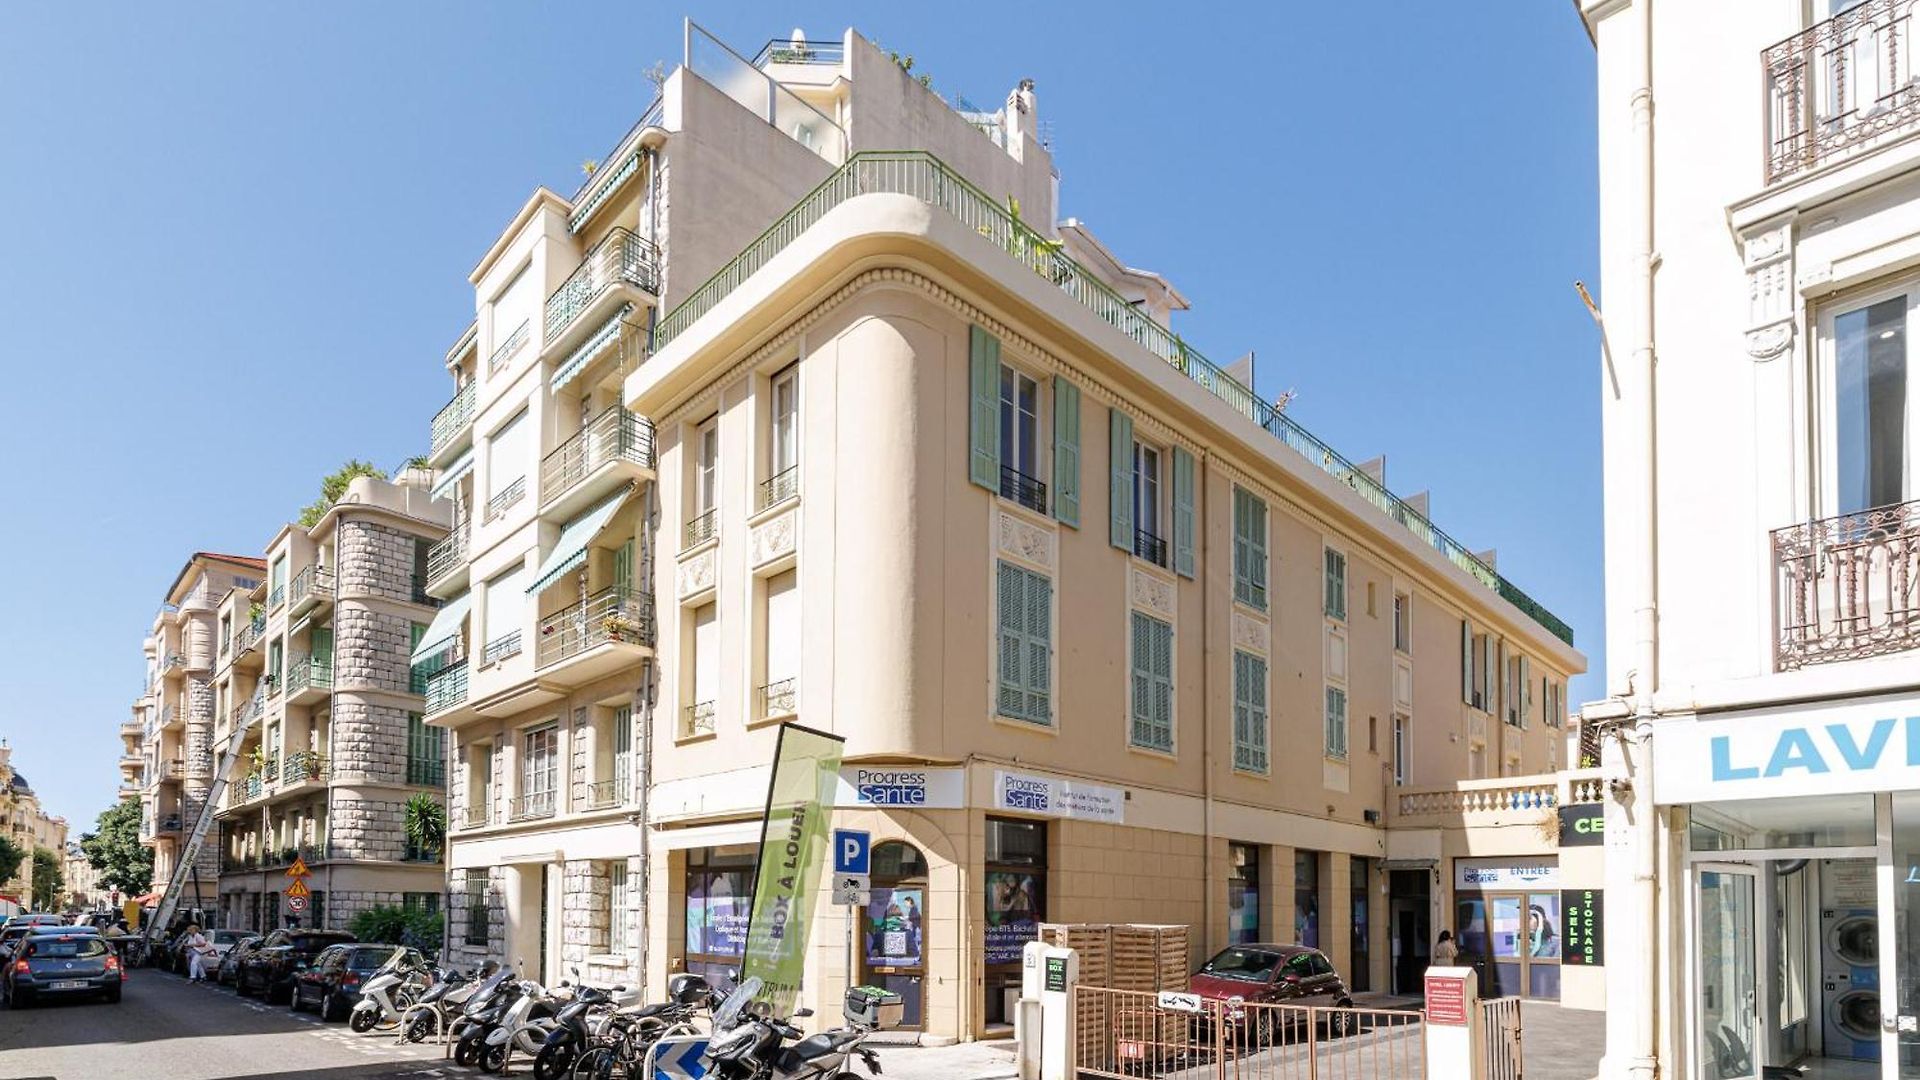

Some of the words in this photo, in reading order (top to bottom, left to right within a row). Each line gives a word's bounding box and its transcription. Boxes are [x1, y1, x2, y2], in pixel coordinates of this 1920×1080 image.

[858, 769, 925, 785] Progress
[1006, 776, 1048, 793] Progress
[844, 838, 860, 866] P
[1510, 863, 1551, 875] ENTRÉE
[776, 874, 795, 889] À
[769, 896, 790, 939] BOX
[1569, 906, 1578, 946] SELF
[1584, 891, 1593, 963] STOCKAGE
